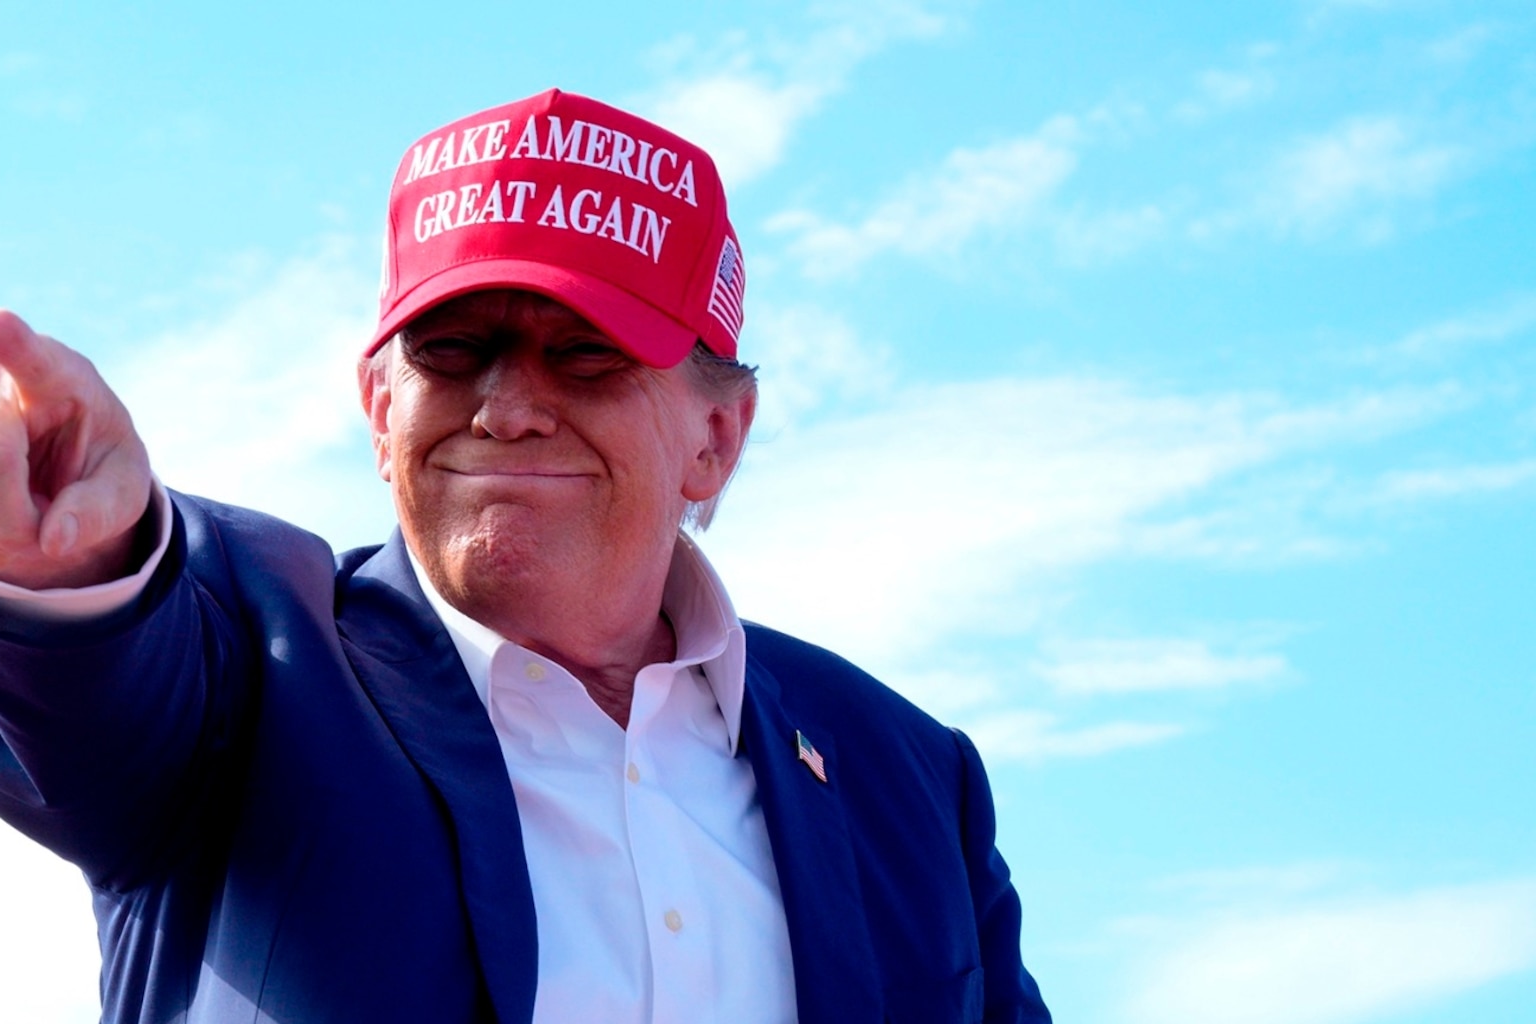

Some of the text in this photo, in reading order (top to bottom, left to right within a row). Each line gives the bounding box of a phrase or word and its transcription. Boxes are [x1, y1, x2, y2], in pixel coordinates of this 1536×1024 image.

[403, 115, 698, 207] MAKE AMERICA
[414, 180, 671, 264] GREAT AGAIN
